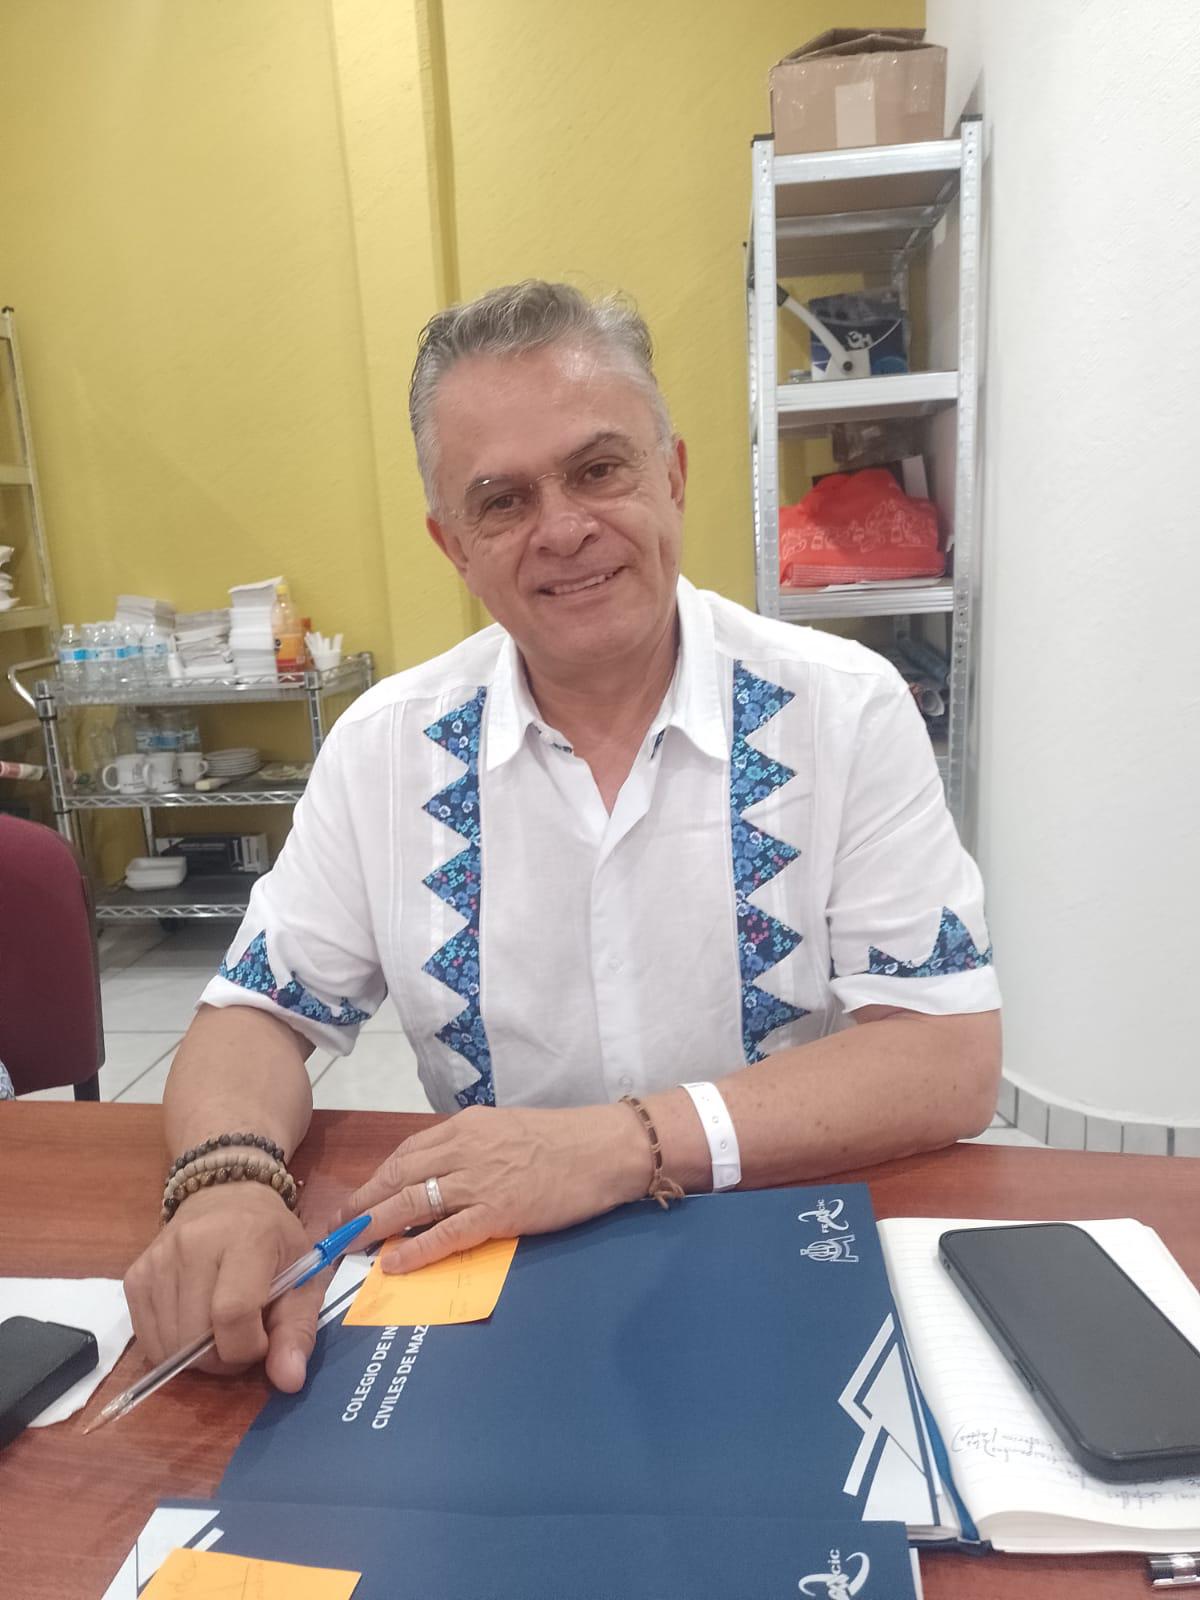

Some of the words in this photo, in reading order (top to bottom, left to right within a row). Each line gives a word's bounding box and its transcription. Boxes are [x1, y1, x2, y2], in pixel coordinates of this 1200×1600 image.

[381, 1326, 399, 1340] IN
[405, 1325, 428, 1354] MAZ
[371, 1342, 392, 1361] DE
[396, 1355, 417, 1375] DE
[342, 1362, 382, 1422] COLEGIO
[372, 1376, 408, 1429] CIVILES
